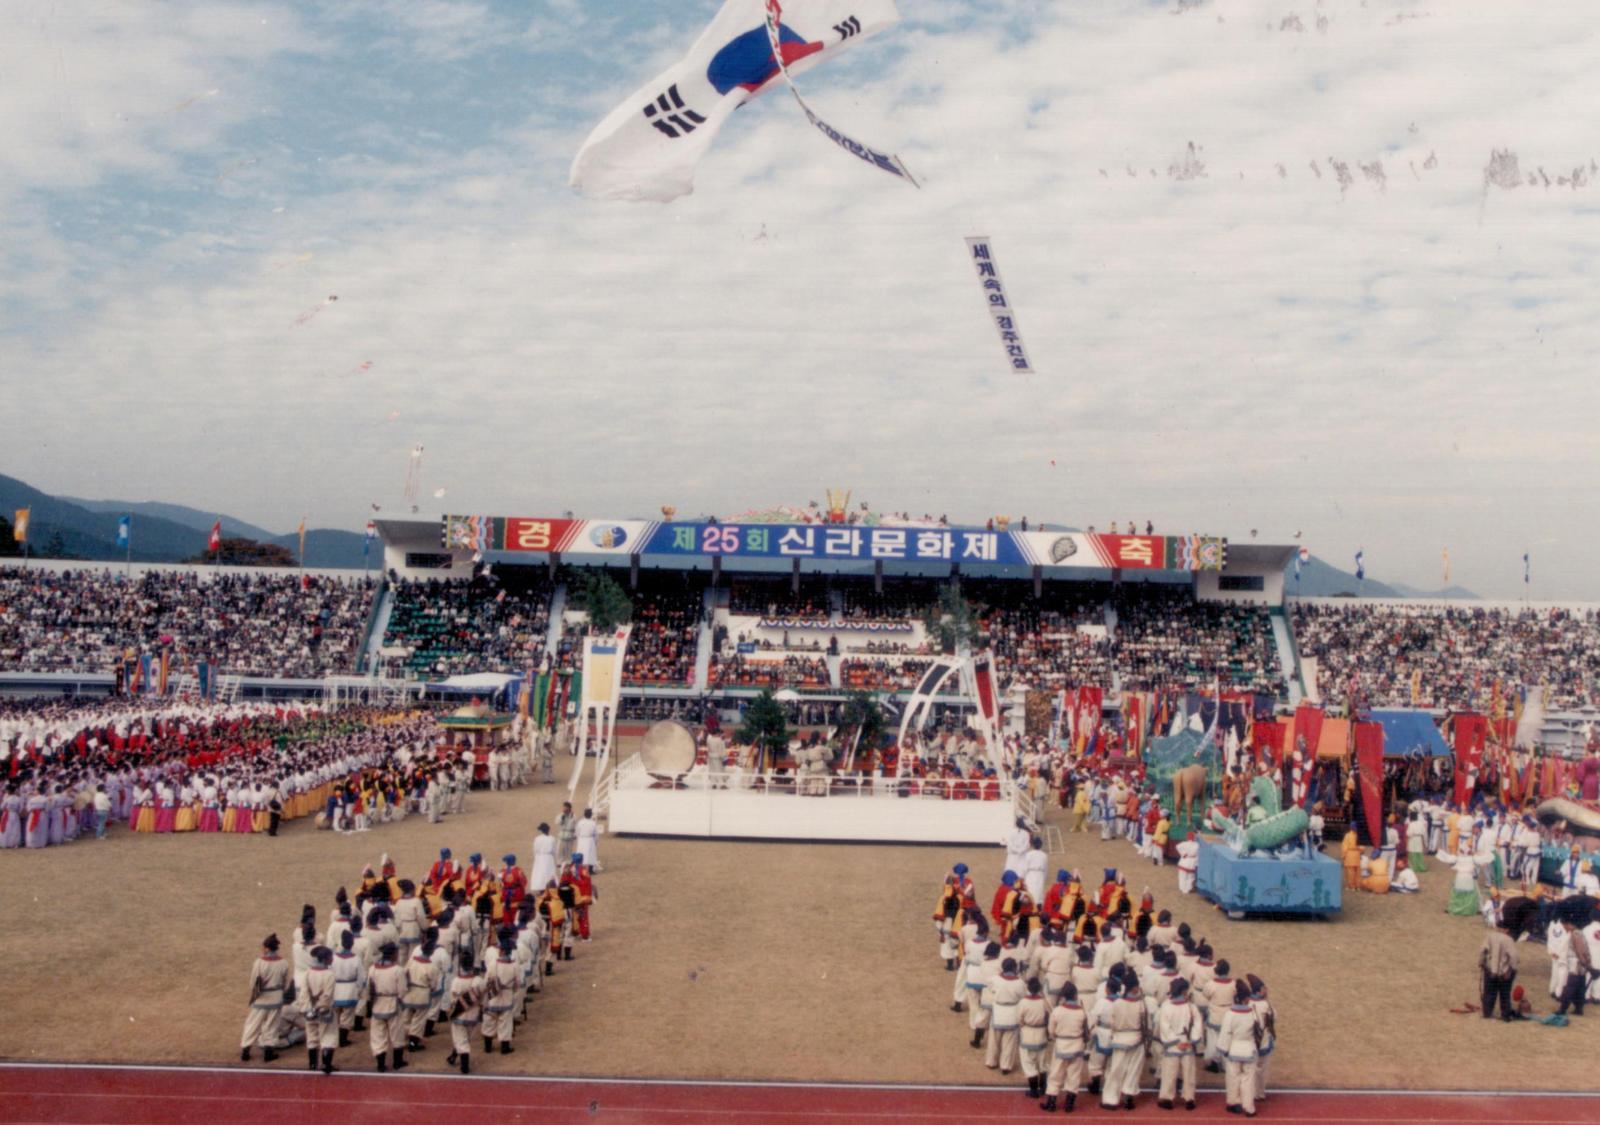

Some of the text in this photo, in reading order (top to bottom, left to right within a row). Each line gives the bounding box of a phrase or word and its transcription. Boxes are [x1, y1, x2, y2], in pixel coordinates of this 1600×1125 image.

[972, 243, 1007, 308] 세계속의
[518, 520, 551, 549] 경
[778, 526, 998, 562] 신라문화제
[1118, 536, 1154, 567] 축
